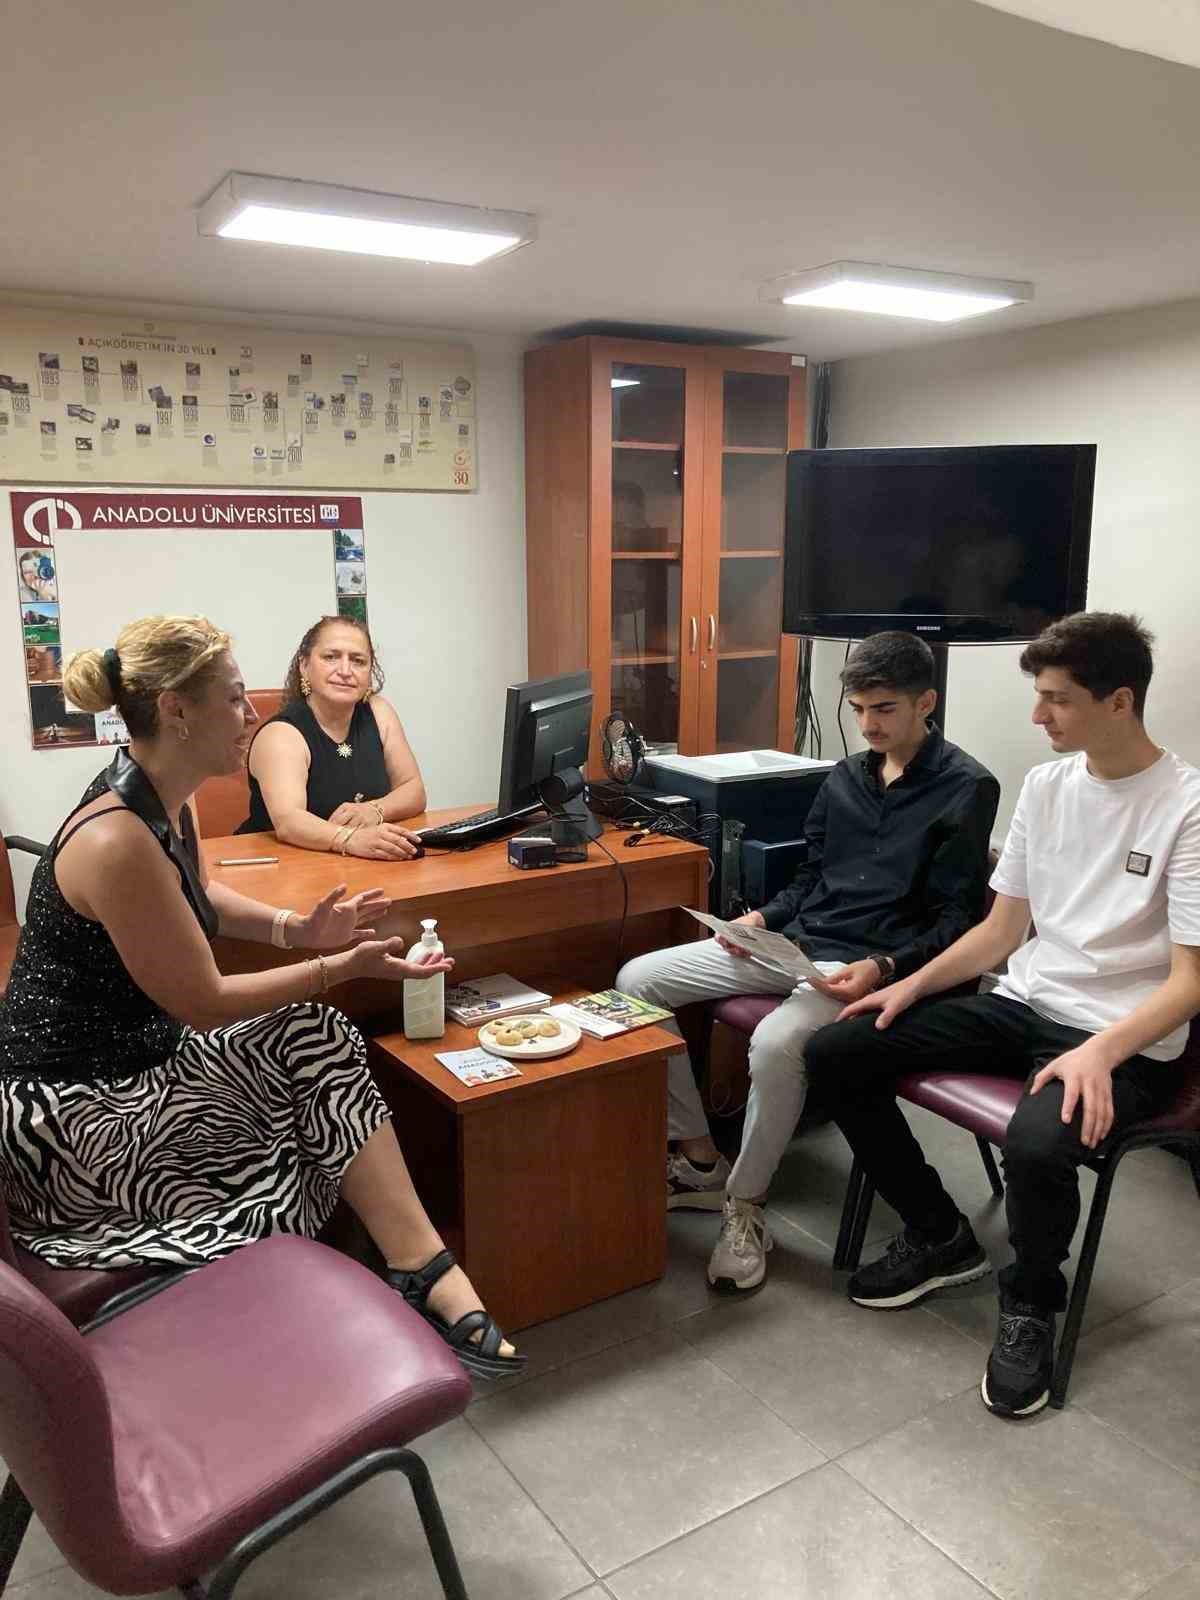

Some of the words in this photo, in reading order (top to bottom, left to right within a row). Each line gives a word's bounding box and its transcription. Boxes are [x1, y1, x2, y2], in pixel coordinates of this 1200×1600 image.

[454, 472, 469, 485] 30
[92, 506, 197, 524] ANADOLU
[202, 504, 316, 524] ÜNİVERSİTESİ
